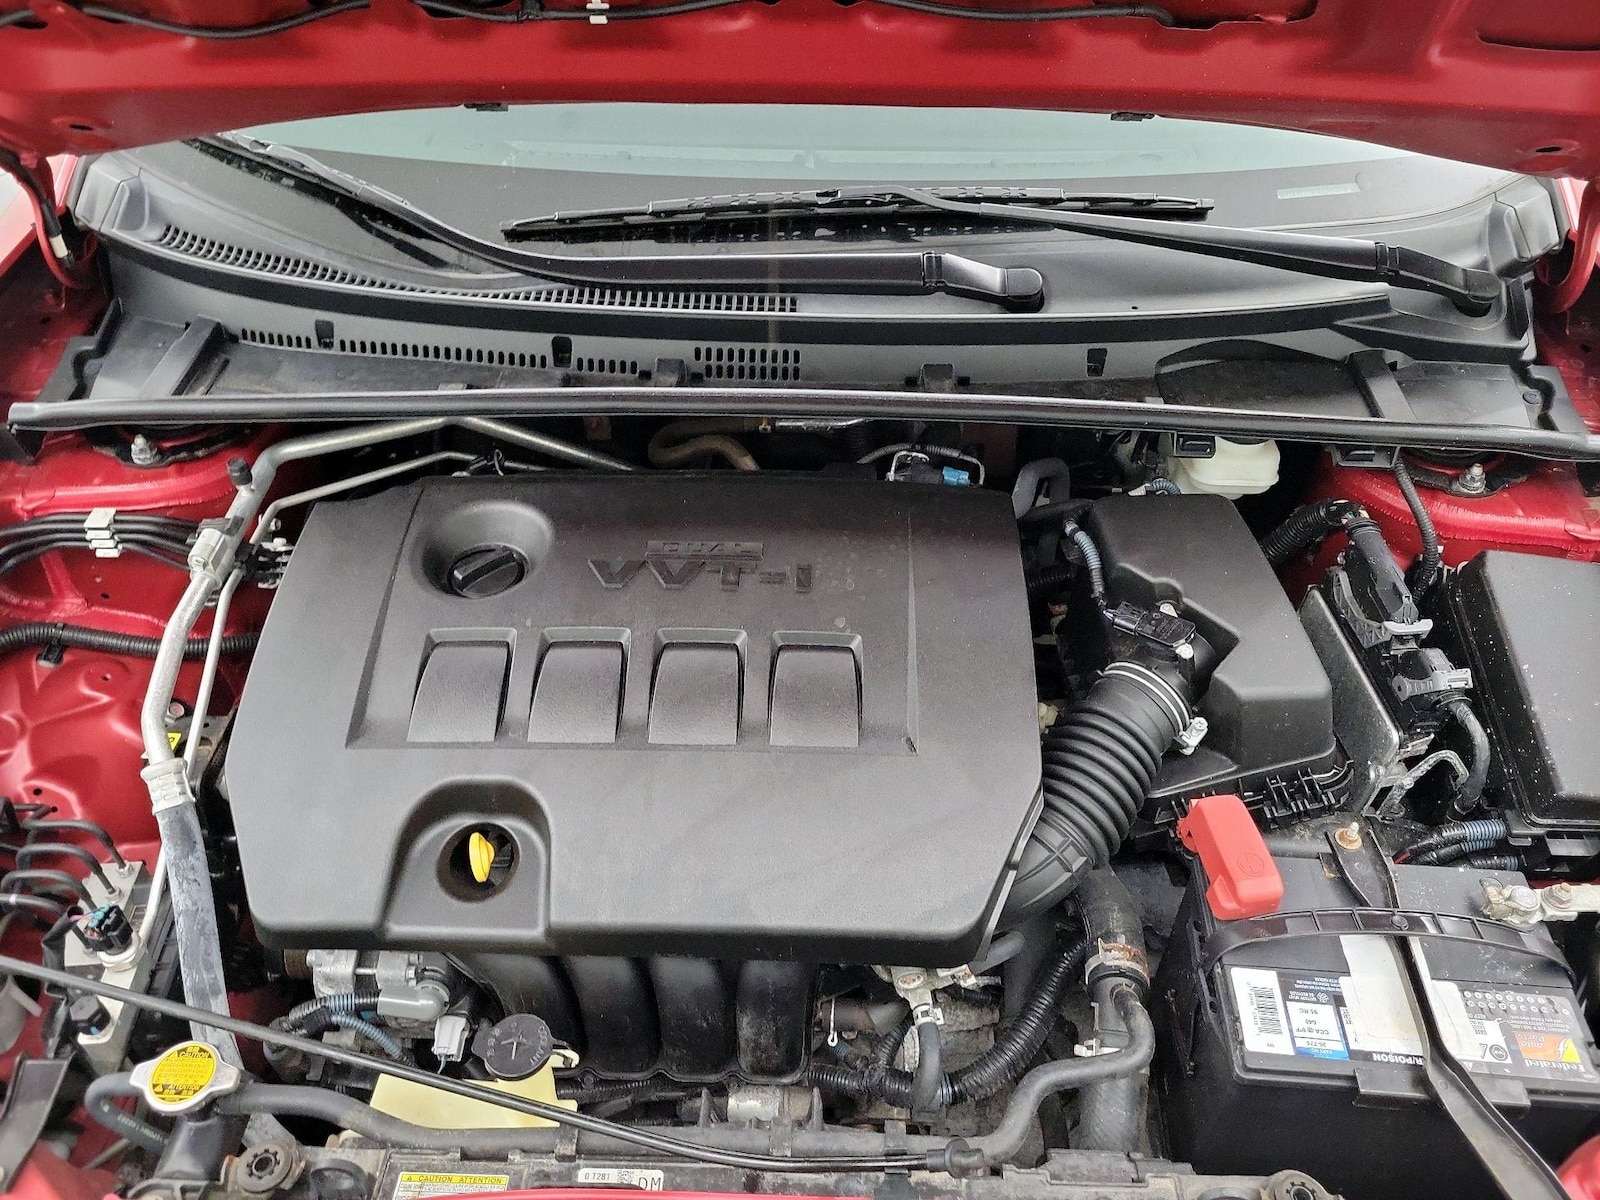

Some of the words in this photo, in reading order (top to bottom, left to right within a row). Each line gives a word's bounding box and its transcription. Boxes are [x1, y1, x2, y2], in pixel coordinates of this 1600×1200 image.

[1518, 1034, 1544, 1042] Parts
[1372, 1053, 1425, 1066] R/POISON
[167, 1083, 200, 1091] ATTENTION
[418, 1174, 453, 1183] CAUTION
[459, 1176, 502, 1184] ATTENTION
